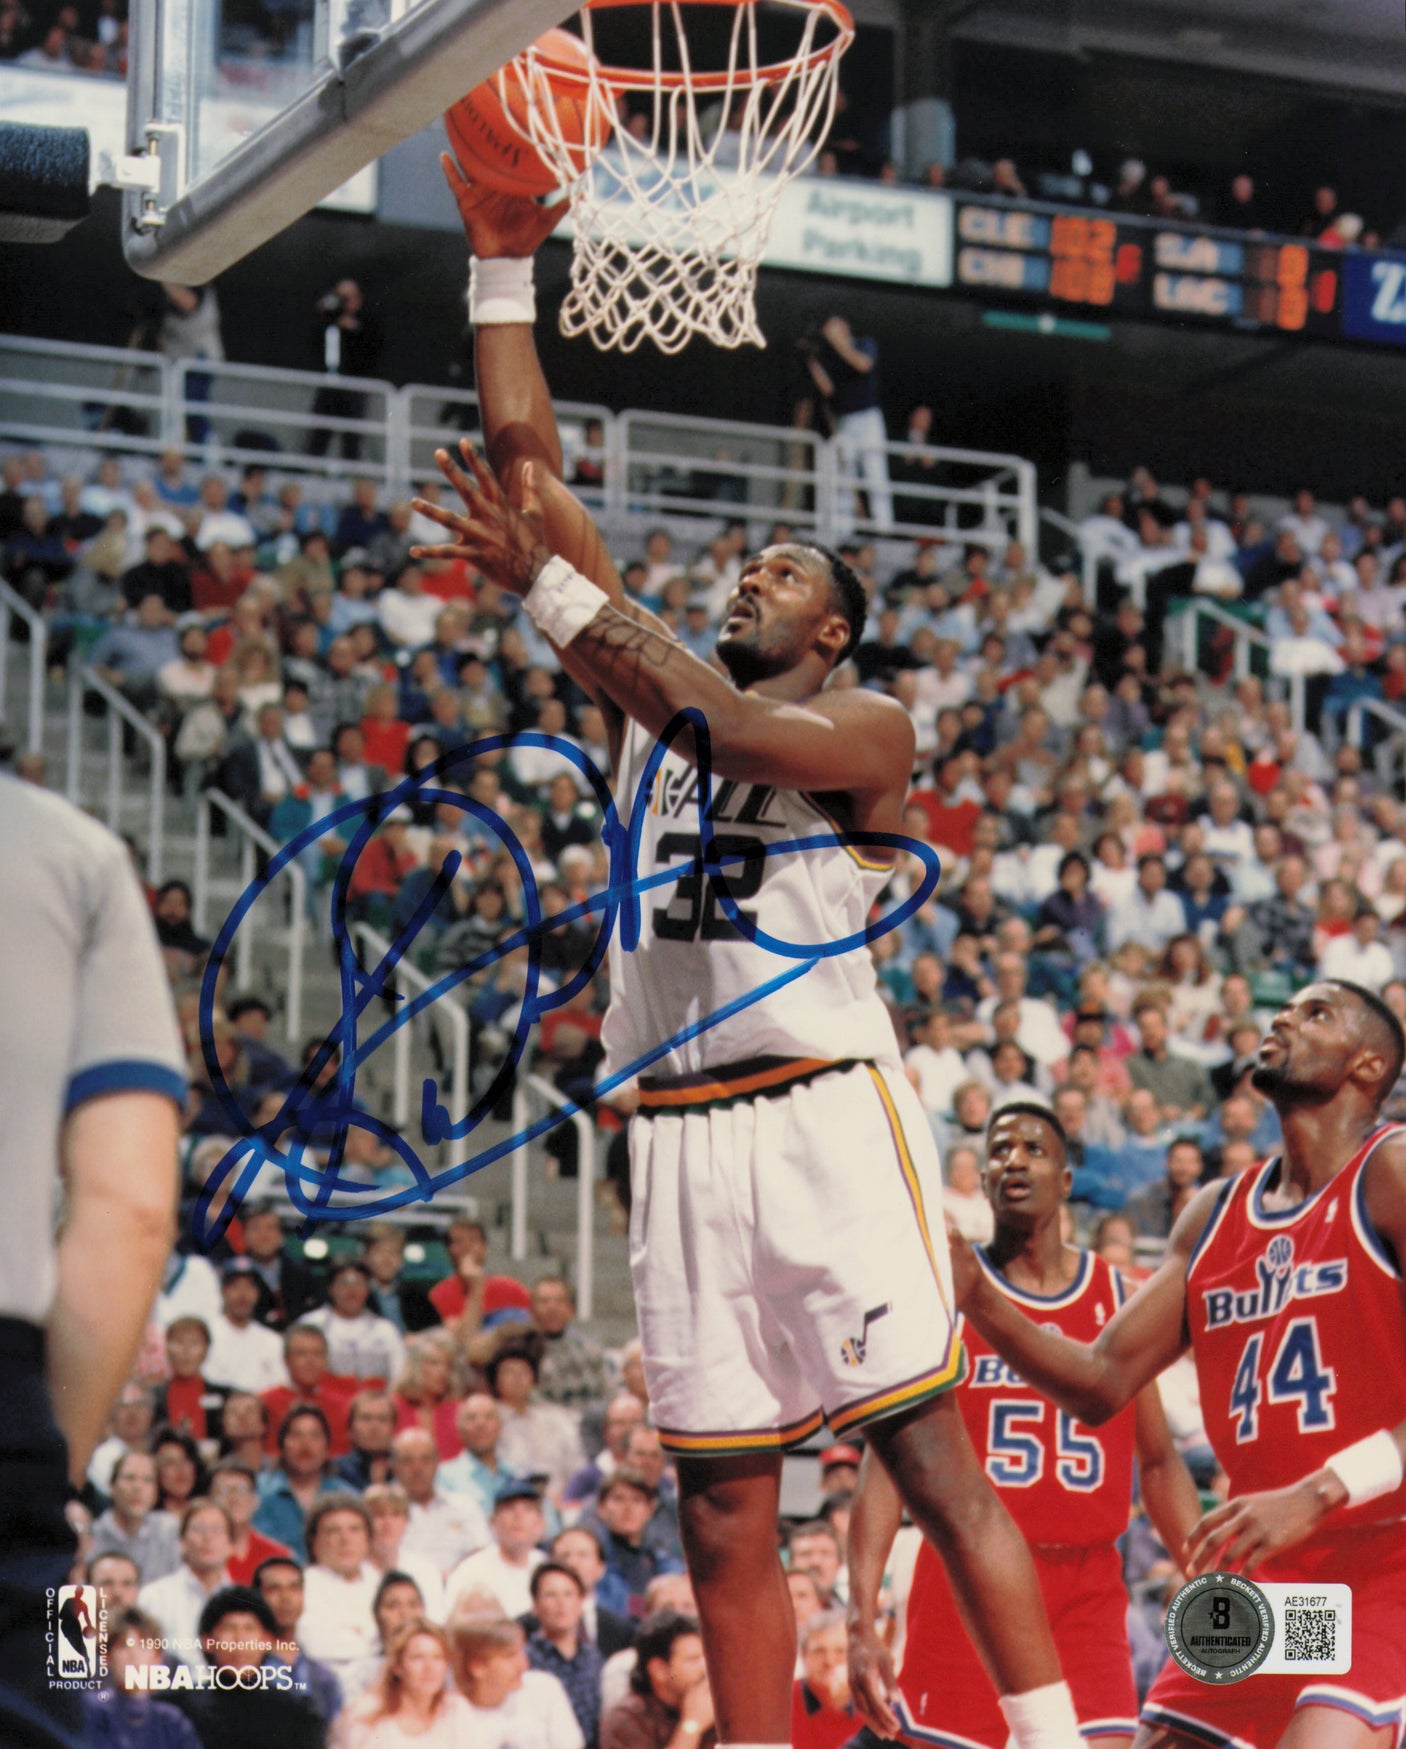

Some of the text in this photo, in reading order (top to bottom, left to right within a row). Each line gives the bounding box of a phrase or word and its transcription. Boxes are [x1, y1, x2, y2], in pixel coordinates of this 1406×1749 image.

[806, 187, 914, 230] Airport
[802, 227, 922, 276] Parking
[652, 832, 767, 943] 32
[1203, 1256, 1348, 1332] Bullts
[1229, 1316, 1337, 1445] 44
[985, 1399, 1105, 1494] 55
[1168, 1577, 1207, 1677] BECKETT VERIFIED AUTHENTIC
[1190, 1636, 1251, 1647] AUTHENTICATED
[1230, 1578, 1269, 1677] BECKETT VERIFIED AUTHENTIC
[1284, 1596, 1327, 1607] AE31677
